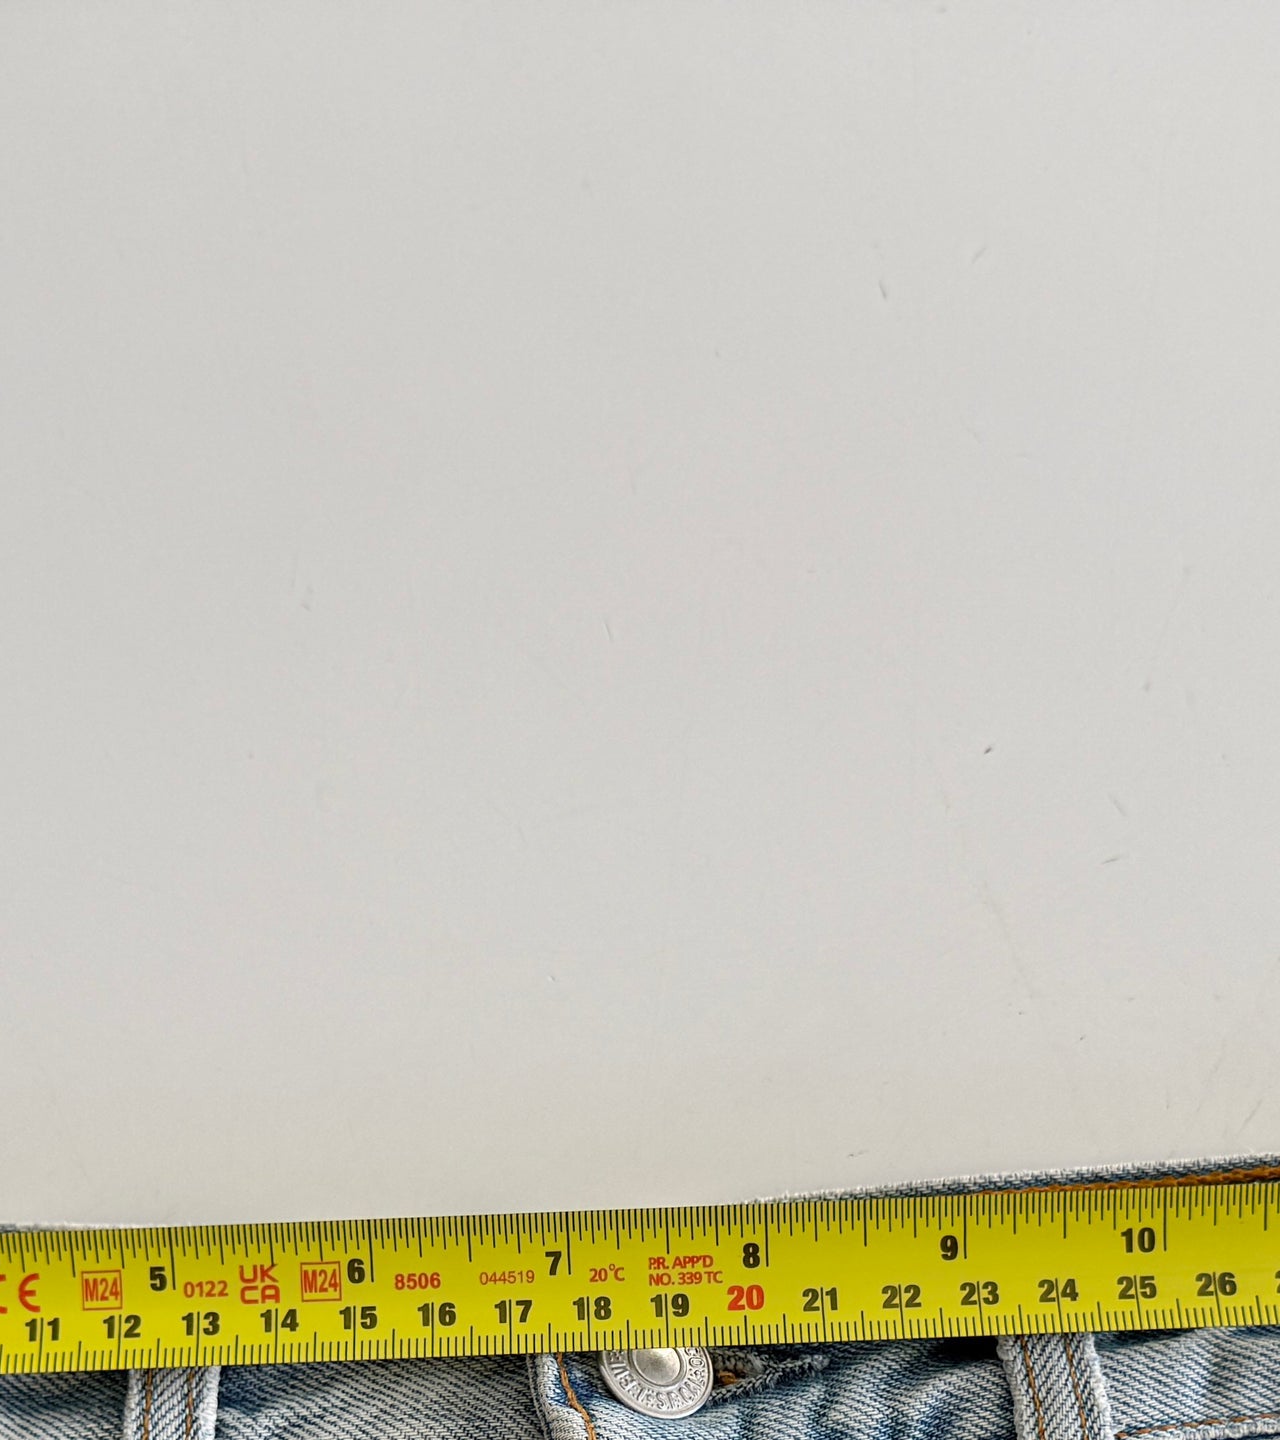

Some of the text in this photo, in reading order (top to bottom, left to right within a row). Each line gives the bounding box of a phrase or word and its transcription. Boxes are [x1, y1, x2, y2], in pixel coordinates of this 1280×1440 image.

[149, 1266, 167, 1291] 5
[347, 1258, 365, 1284] 6
[545, 1251, 562, 1276] 7
[742, 1243, 760, 1268] 8
[940, 1235, 959, 1260] 9
[1121, 1227, 1156, 1253] 10
[239, 1264, 279, 1284] UK
[303, 1268, 339, 1293] M24
[394, 1272, 441, 1290] 8506
[479, 1269, 535, 1286] 044519
[649, 1270, 723, 1287] NO. 339 TC
[84, 1277, 120, 1302] M24
[183, 1280, 228, 1298] 0122
[240, 1285, 280, 1304] CA
[25, 1317, 60, 1341] 11
[103, 1314, 141, 1339] 12
[182, 1312, 220, 1336] 13
[260, 1308, 299, 1333] 14
[339, 1305, 378, 1330] 15
[417, 1302, 456, 1327] 16
[494, 1300, 532, 1324] 17
[573, 1296, 612, 1321] 18
[650, 1293, 690, 1318] 19
[727, 1284, 765, 1311] 20
[802, 1287, 838, 1312] 21
[882, 1284, 922, 1309] 22
[959, 1281, 999, 1306] 23
[1038, 1278, 1078, 1303] 24
[1117, 1275, 1157, 1300] 25
[1195, 1272, 1237, 1297] 26
